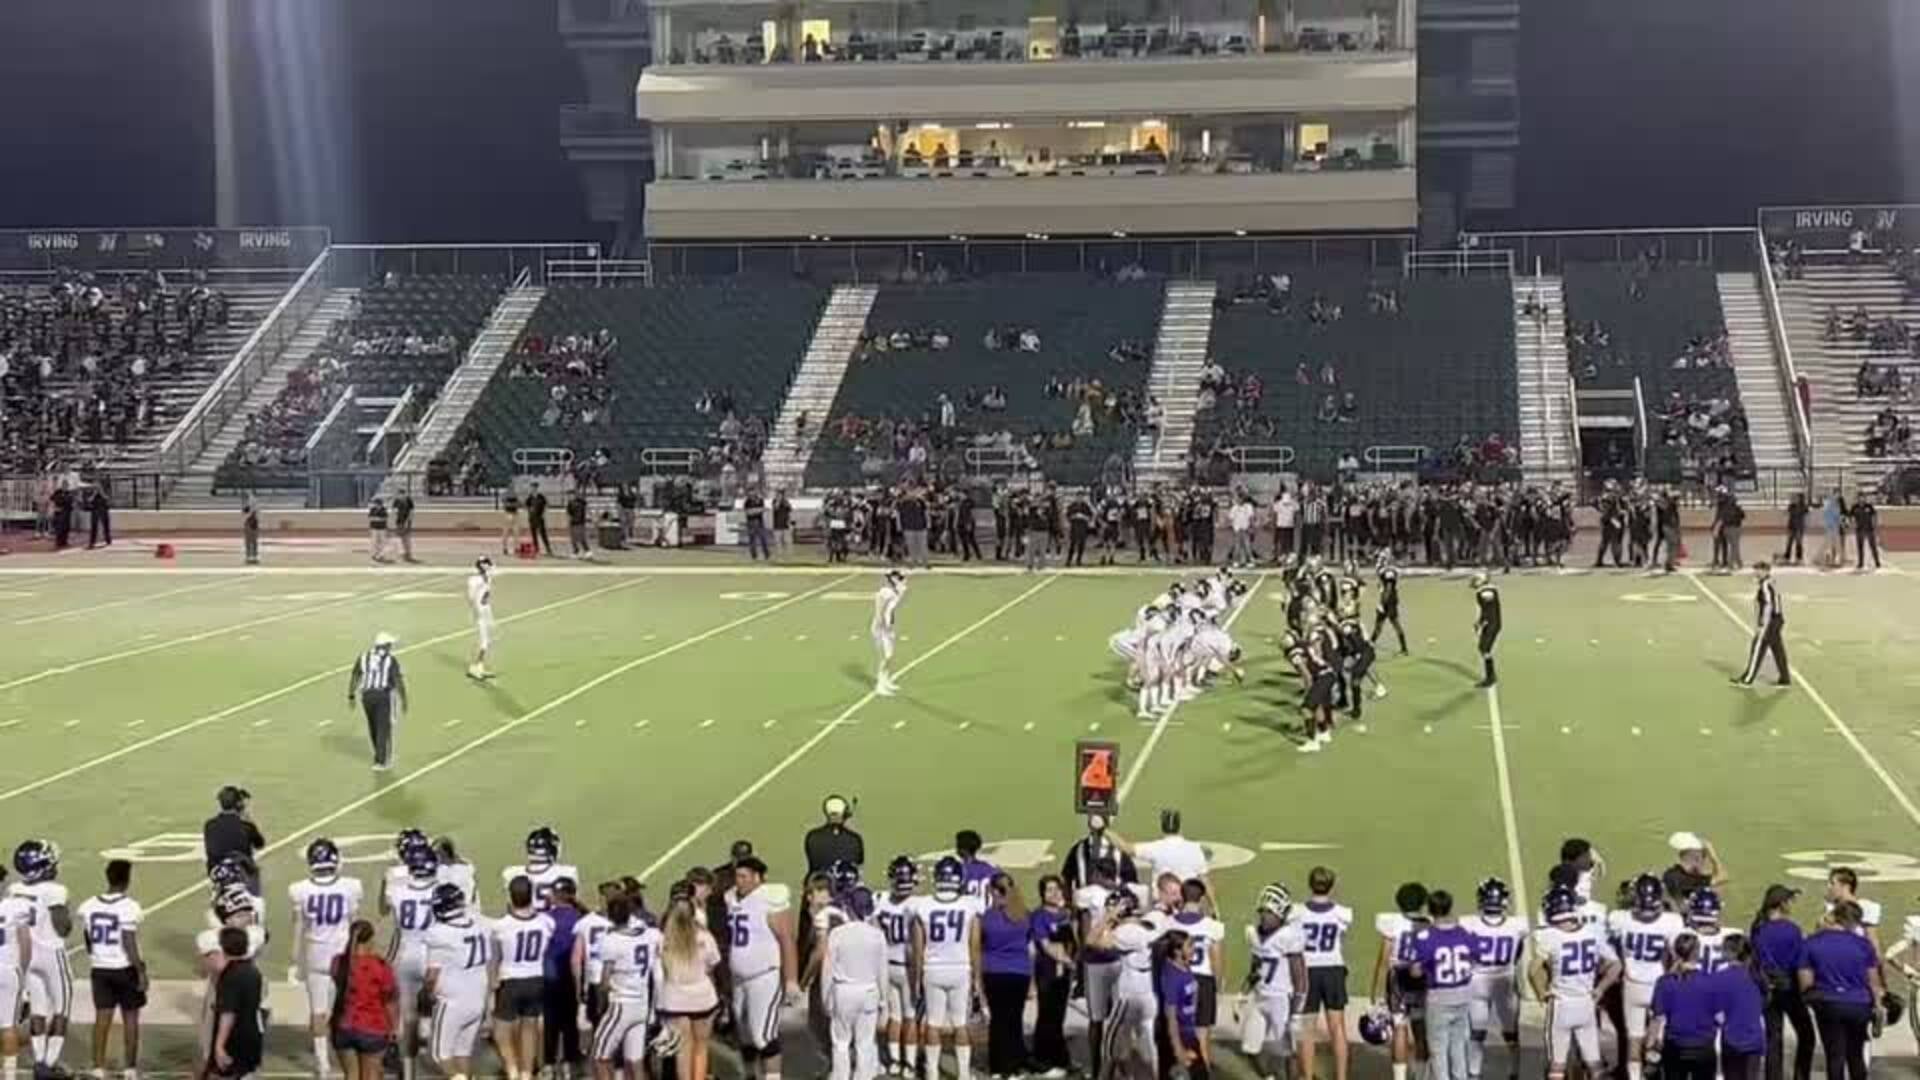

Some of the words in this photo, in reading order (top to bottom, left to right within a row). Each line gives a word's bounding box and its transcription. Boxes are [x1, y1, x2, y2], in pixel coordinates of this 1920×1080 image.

[1796, 210, 1852, 227] IRVING
[28, 234, 78, 248] IRVING
[240, 233, 290, 248] IRVING
[307, 893, 343, 925] 40
[400, 899, 433, 931] 87
[89, 911, 119, 945] 62
[929, 910, 965, 943] 64
[1302, 923, 1337, 952] 28
[463, 936, 487, 969] 71
[514, 929, 543, 962] 10
[633, 944, 649, 977] 9
[1480, 935, 1514, 967] 20
[1561, 938, 1597, 977] 26
[1625, 931, 1665, 963] 45
[1434, 944, 1471, 983] 26
